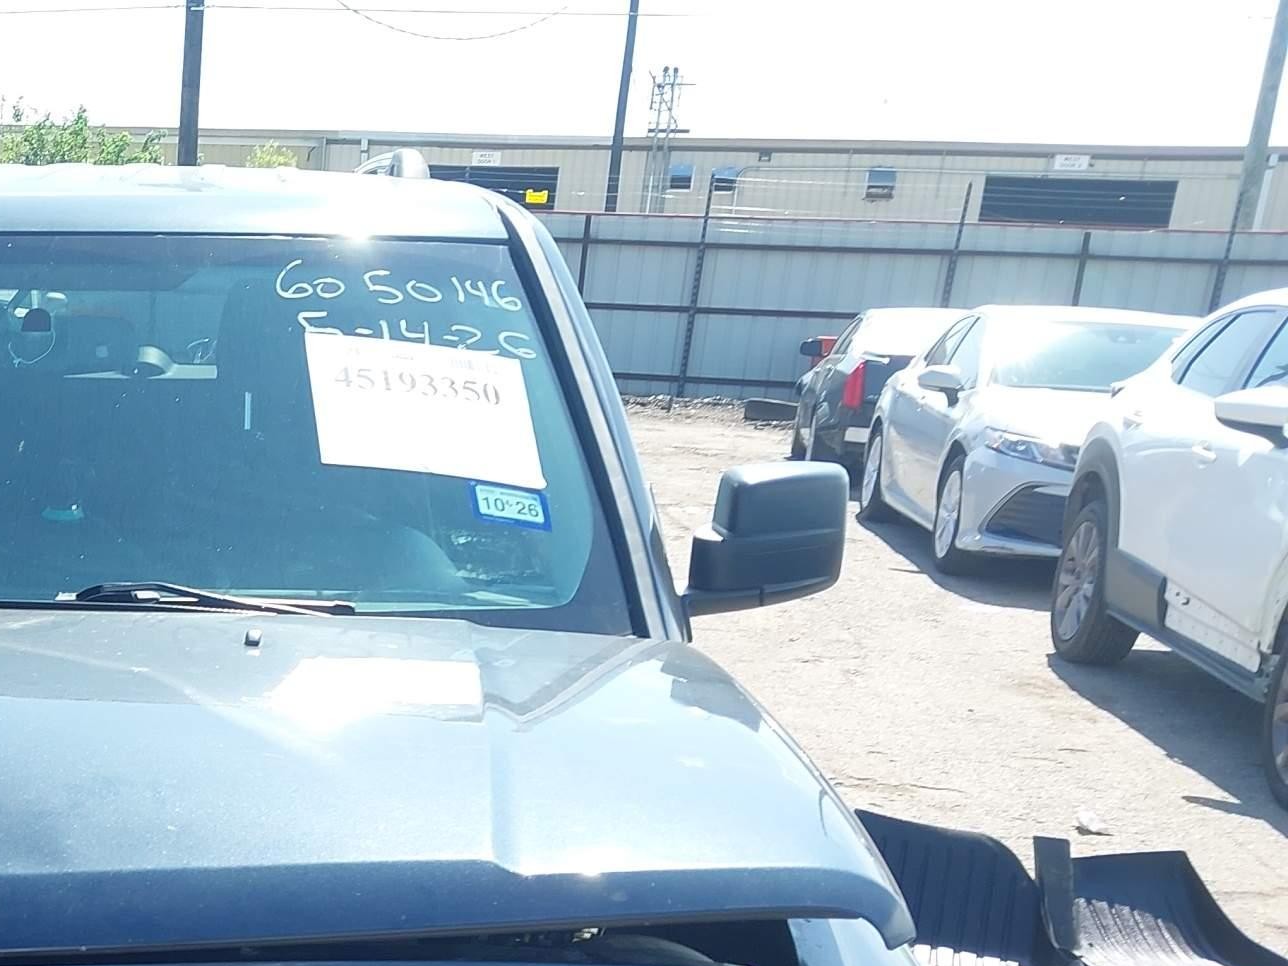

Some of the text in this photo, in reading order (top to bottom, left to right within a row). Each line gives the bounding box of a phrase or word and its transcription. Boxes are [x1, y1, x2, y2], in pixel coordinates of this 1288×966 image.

[333, 365, 501, 406] 45193350
[481, 497, 539, 517] 10 26
